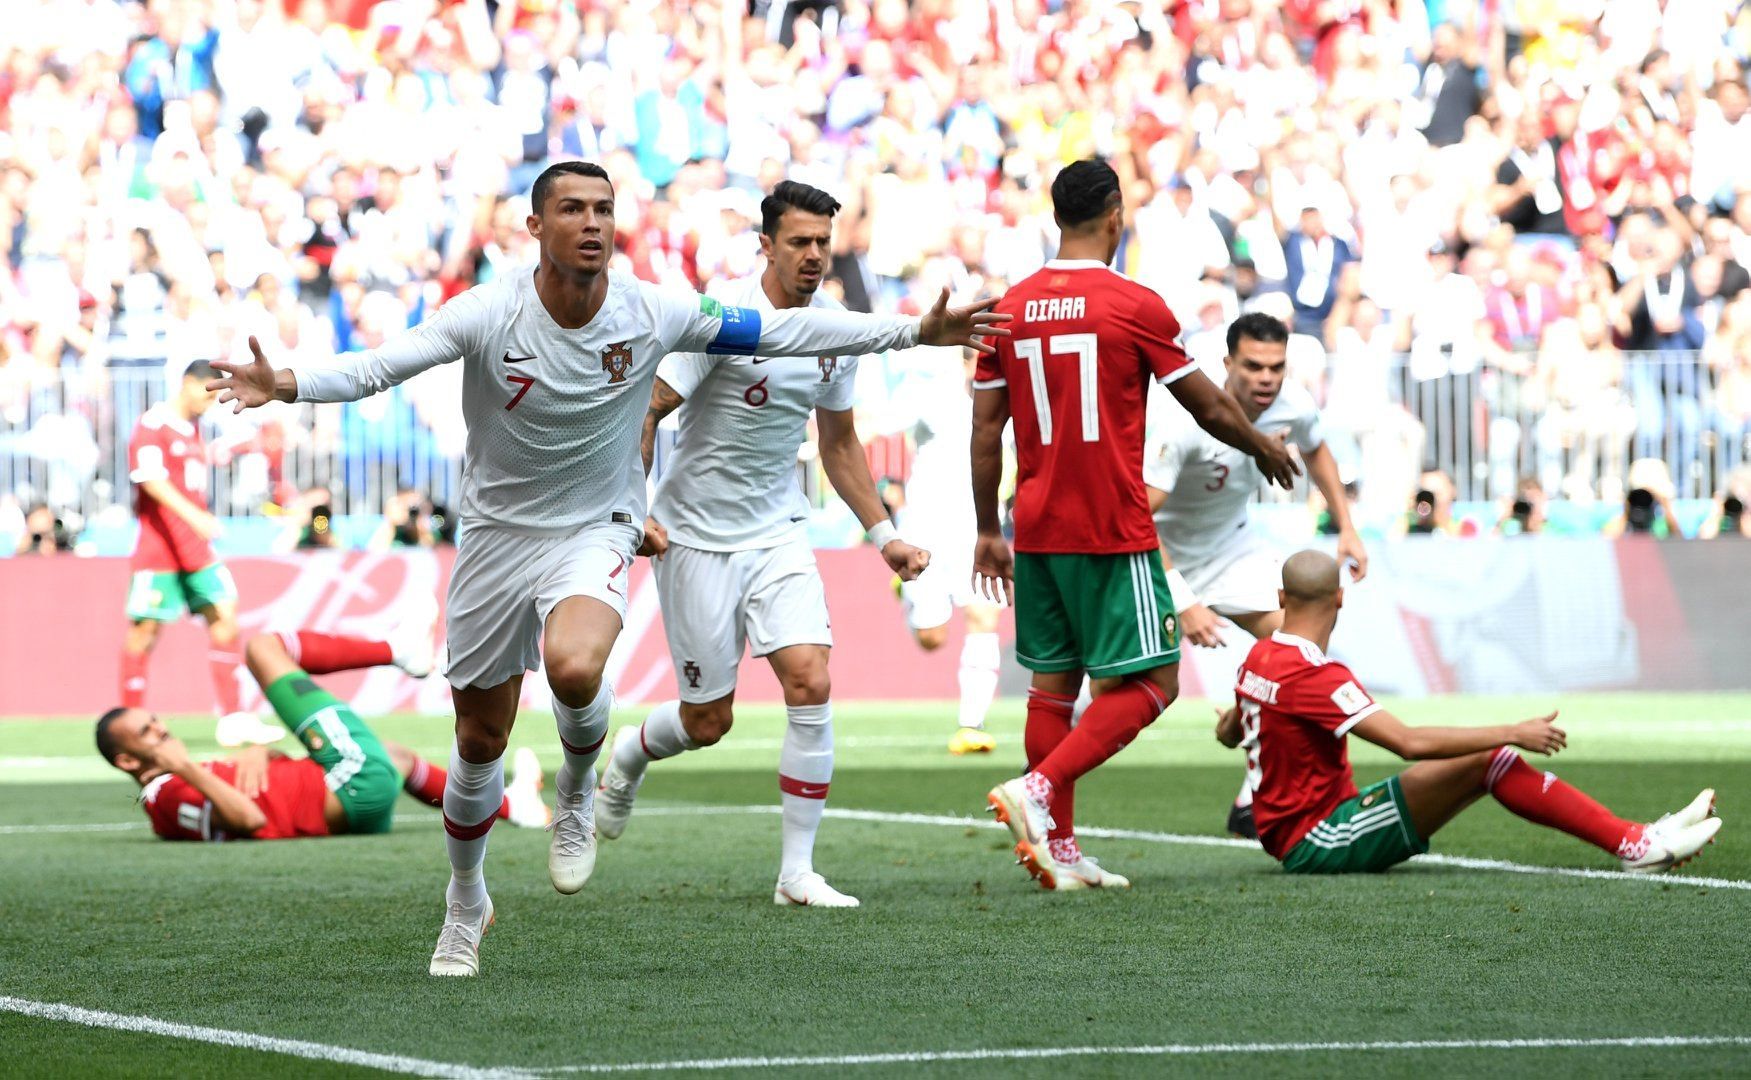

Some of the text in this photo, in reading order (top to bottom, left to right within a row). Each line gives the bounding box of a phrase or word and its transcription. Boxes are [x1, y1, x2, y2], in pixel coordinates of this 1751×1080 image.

[504, 375, 536, 411] 7
[744, 374, 769, 407] 6
[1013, 333, 1100, 446] 17
[1205, 464, 1229, 492] 3
